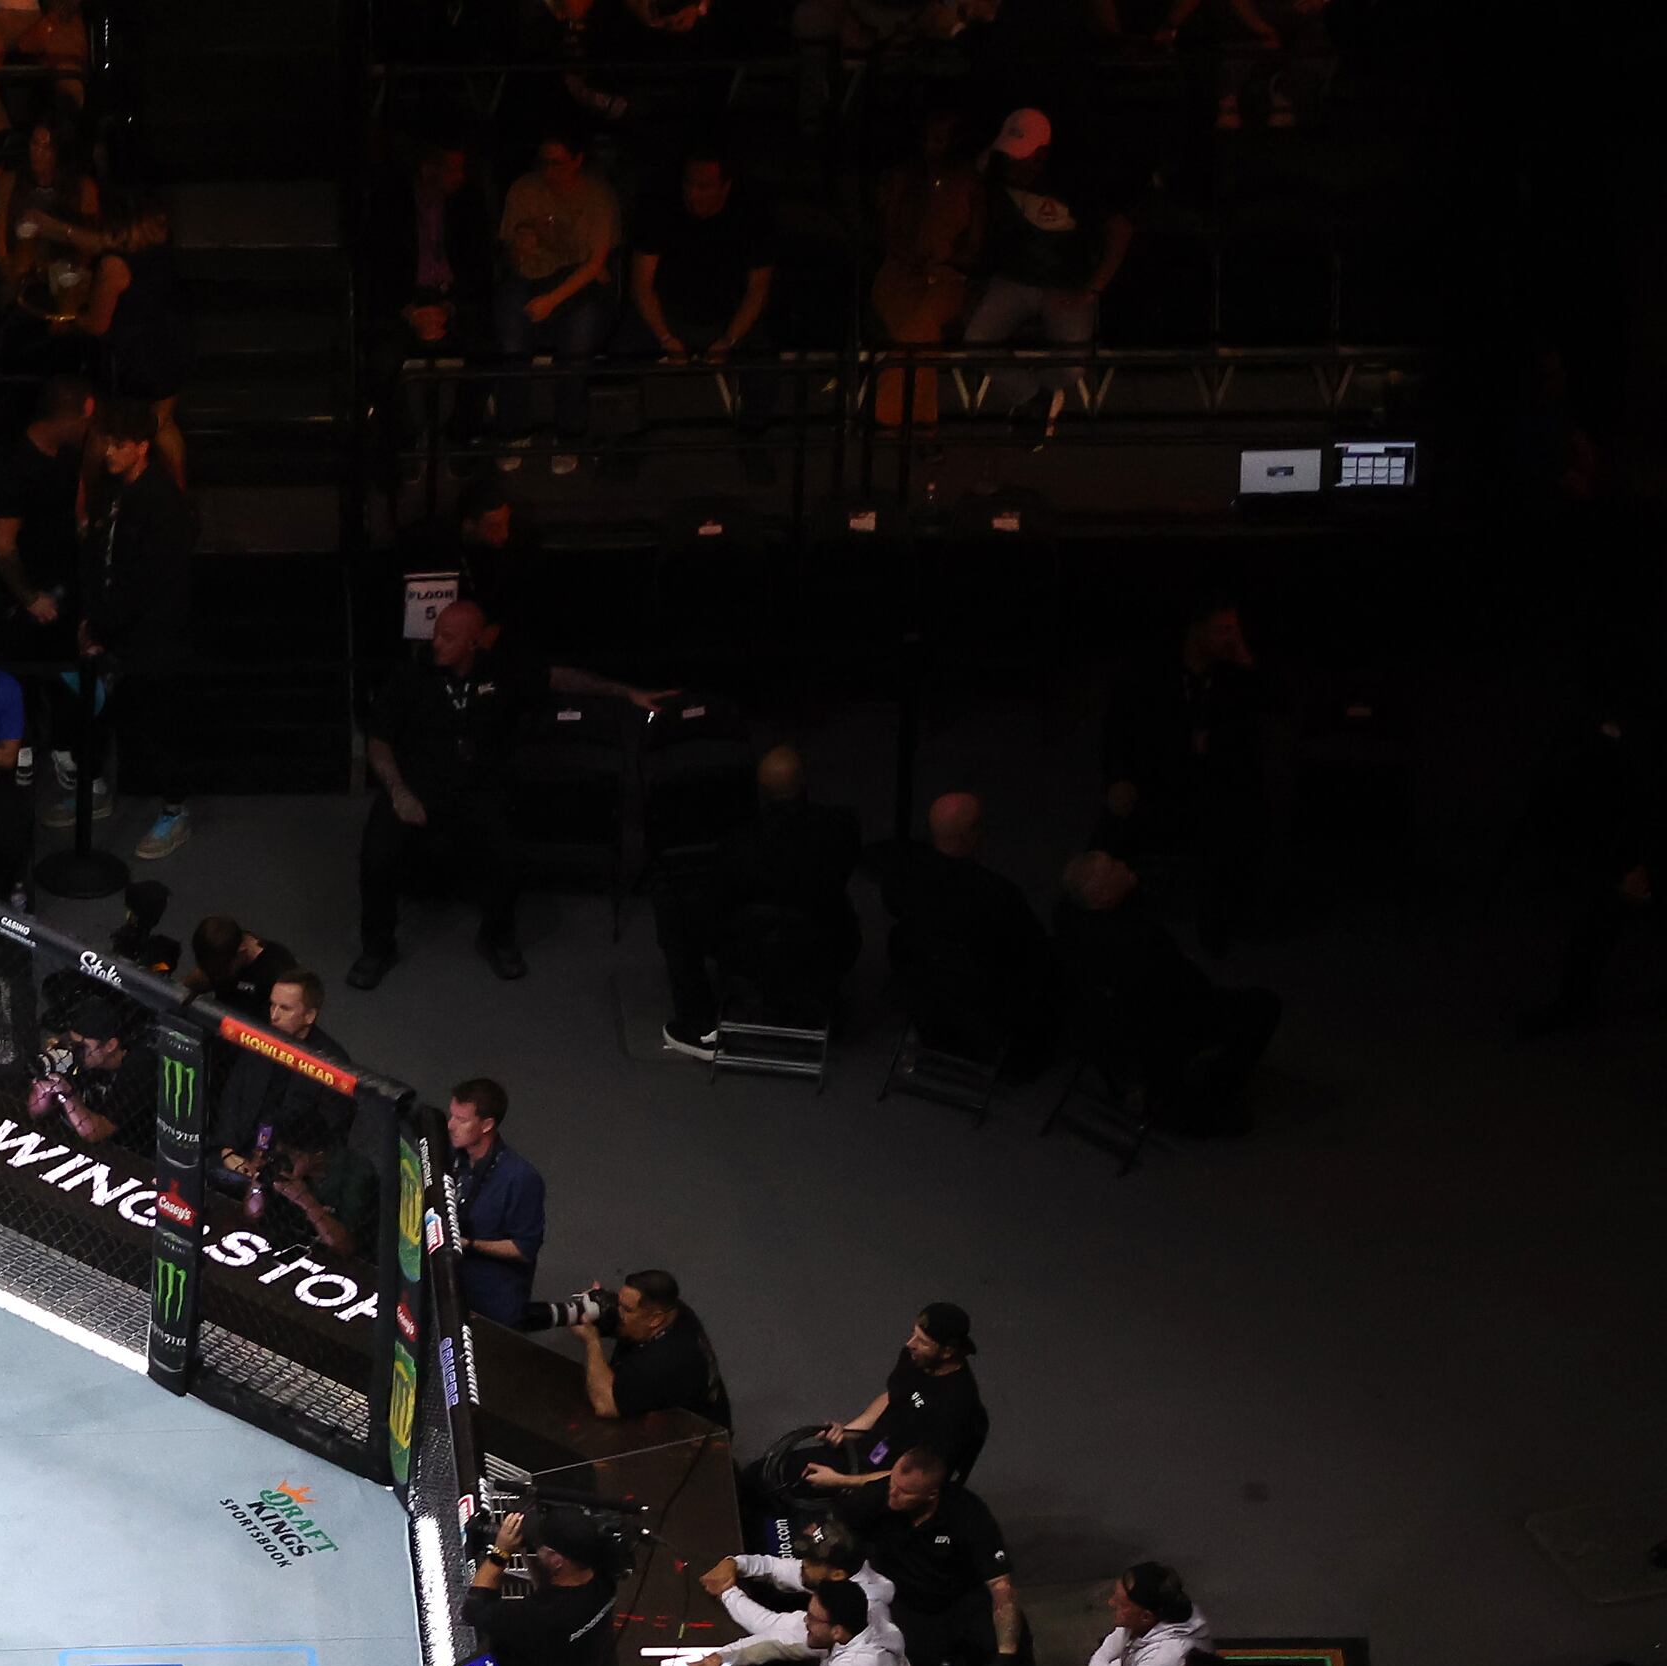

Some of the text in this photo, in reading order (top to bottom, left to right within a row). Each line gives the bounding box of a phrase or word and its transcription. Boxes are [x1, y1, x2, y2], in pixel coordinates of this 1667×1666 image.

[407, 589, 454, 601] FLOOR
[425, 606, 437, 621] 5
[0, 916, 31, 937] CASINO
[80, 951, 123, 986] Stake
[240, 1032, 335, 1086] HOWLER HEAD
[158, 1195, 192, 1221] Casey's
[220, 1498, 293, 1568] SPORTSBOOK
[246, 1499, 313, 1557] KINGS
[259, 1489, 339, 1552] DRAFT
